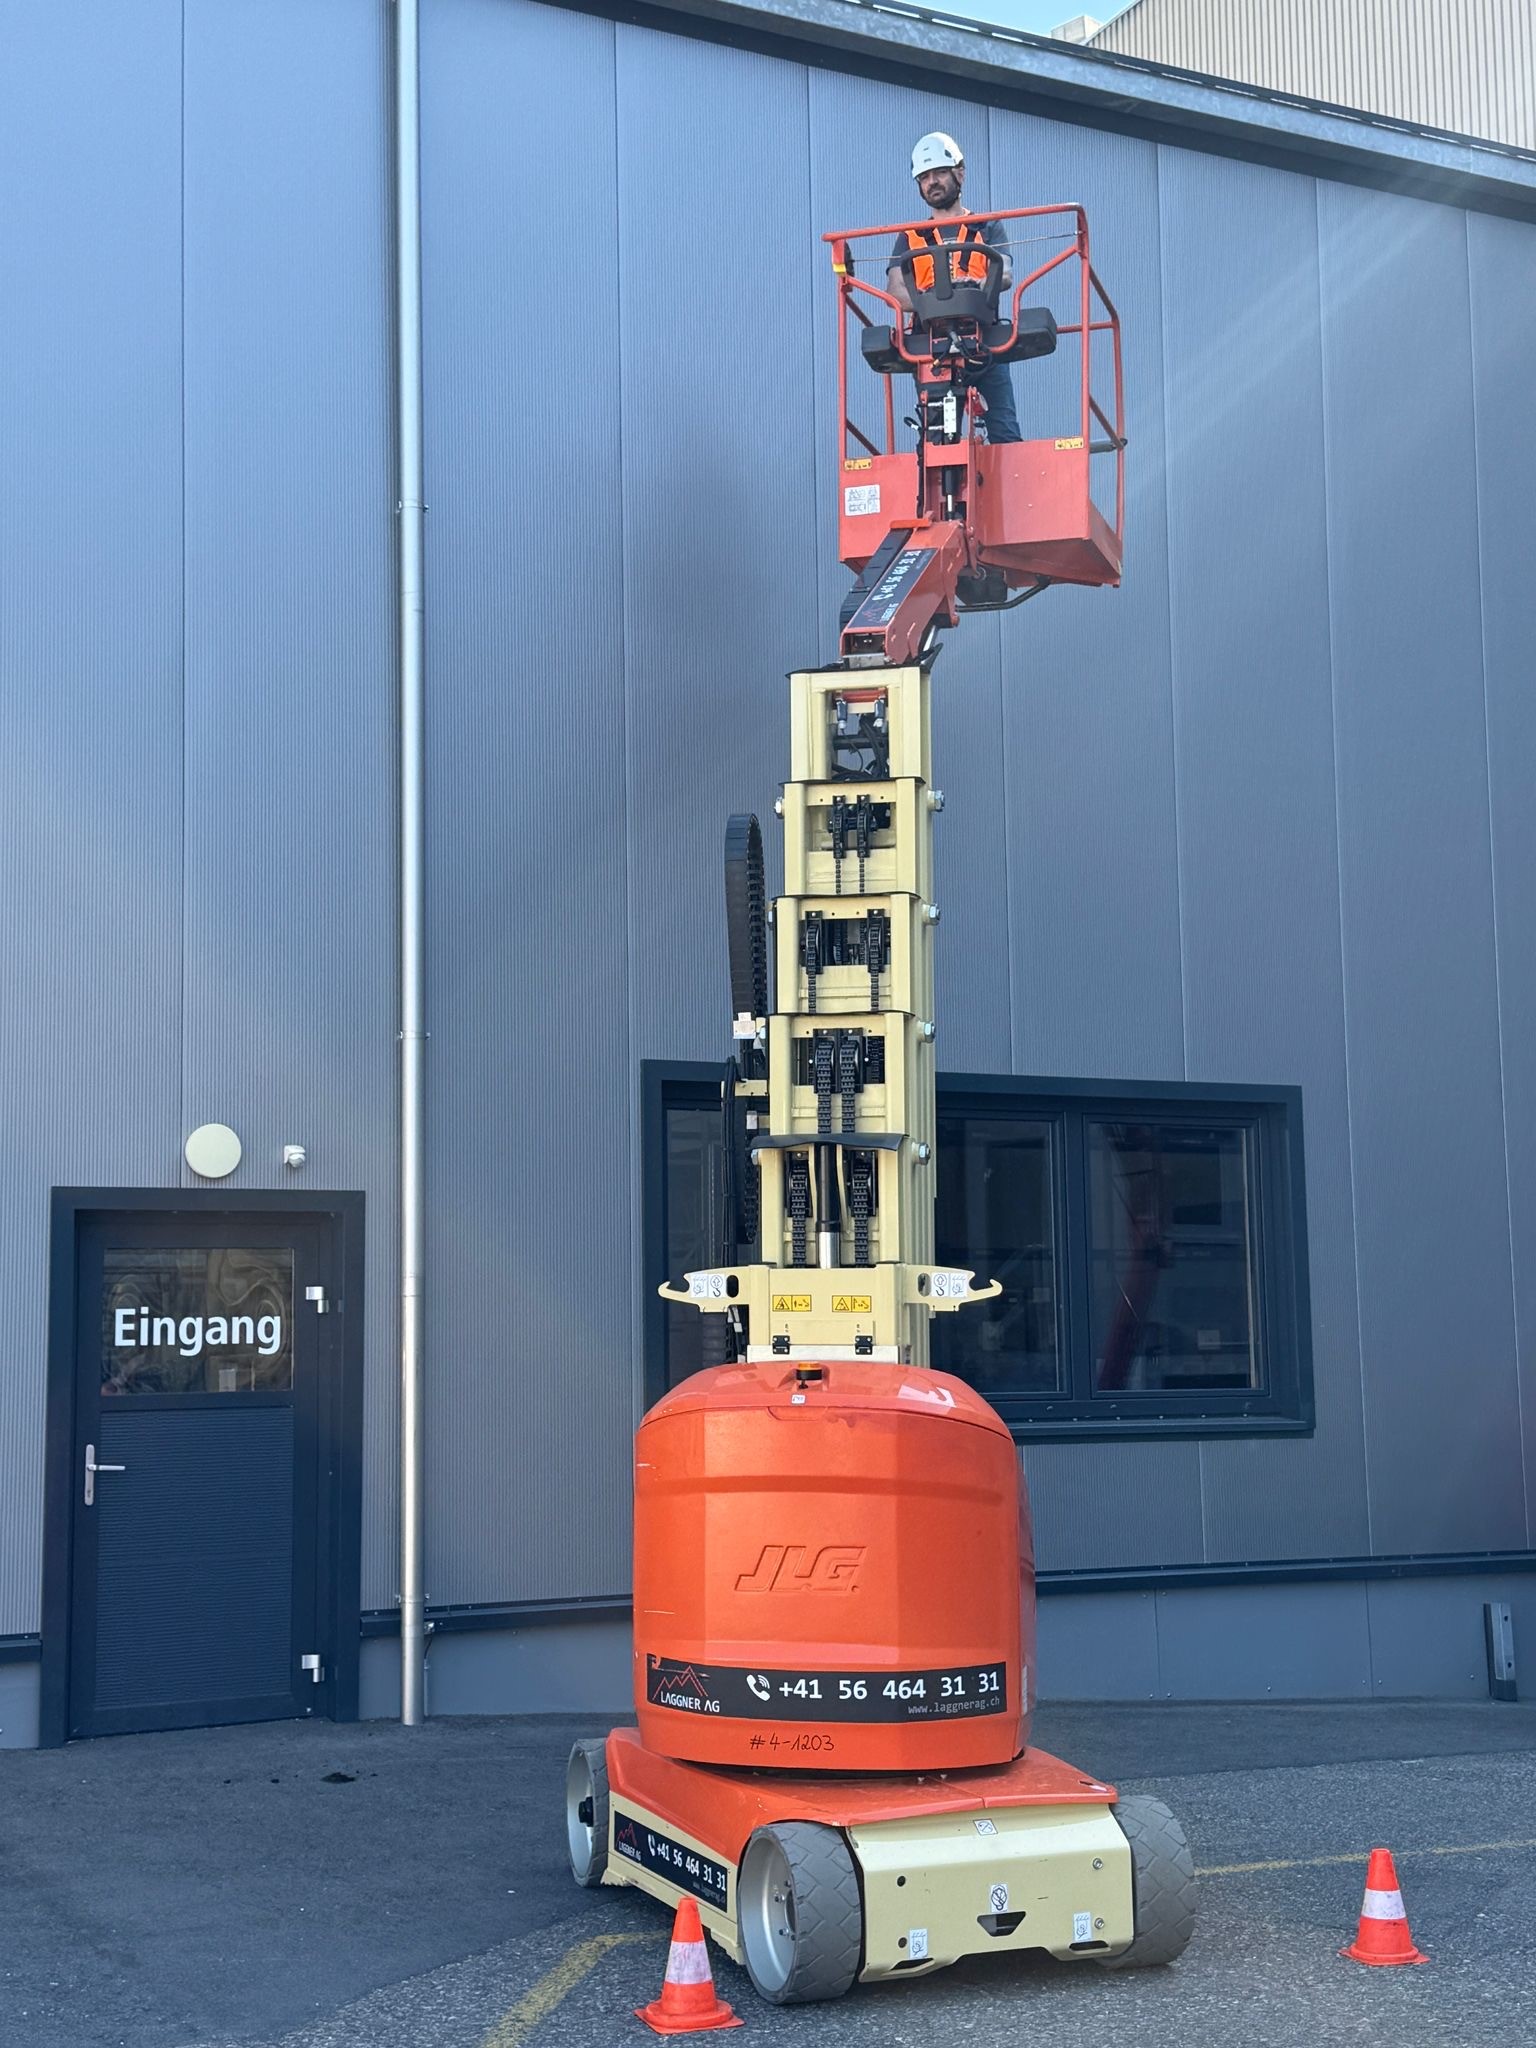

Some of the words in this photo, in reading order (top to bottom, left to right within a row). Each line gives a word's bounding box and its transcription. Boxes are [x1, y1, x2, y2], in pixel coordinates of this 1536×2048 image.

[114, 1306, 281, 1356] Eingang
[734, 1544, 867, 1592] JLG
[660, 1690, 701, 1710] LAGGNER
[704, 1699, 720, 1713] AG
[778, 1678, 823, 1699] +41
[839, 1679, 868, 1700] 56
[882, 1678, 926, 1699] 464
[940, 1675, 966, 1697] 31
[978, 1671, 1000, 1693] 31
[908, 1696, 1000, 1714] www.laggnerag.ch
[657, 1843, 670, 1861] +41
[673, 1848, 683, 1867] 56
[685, 1856, 700, 1877] 464
[703, 1864, 713, 1884] 31
[716, 1871, 727, 1891] 31
